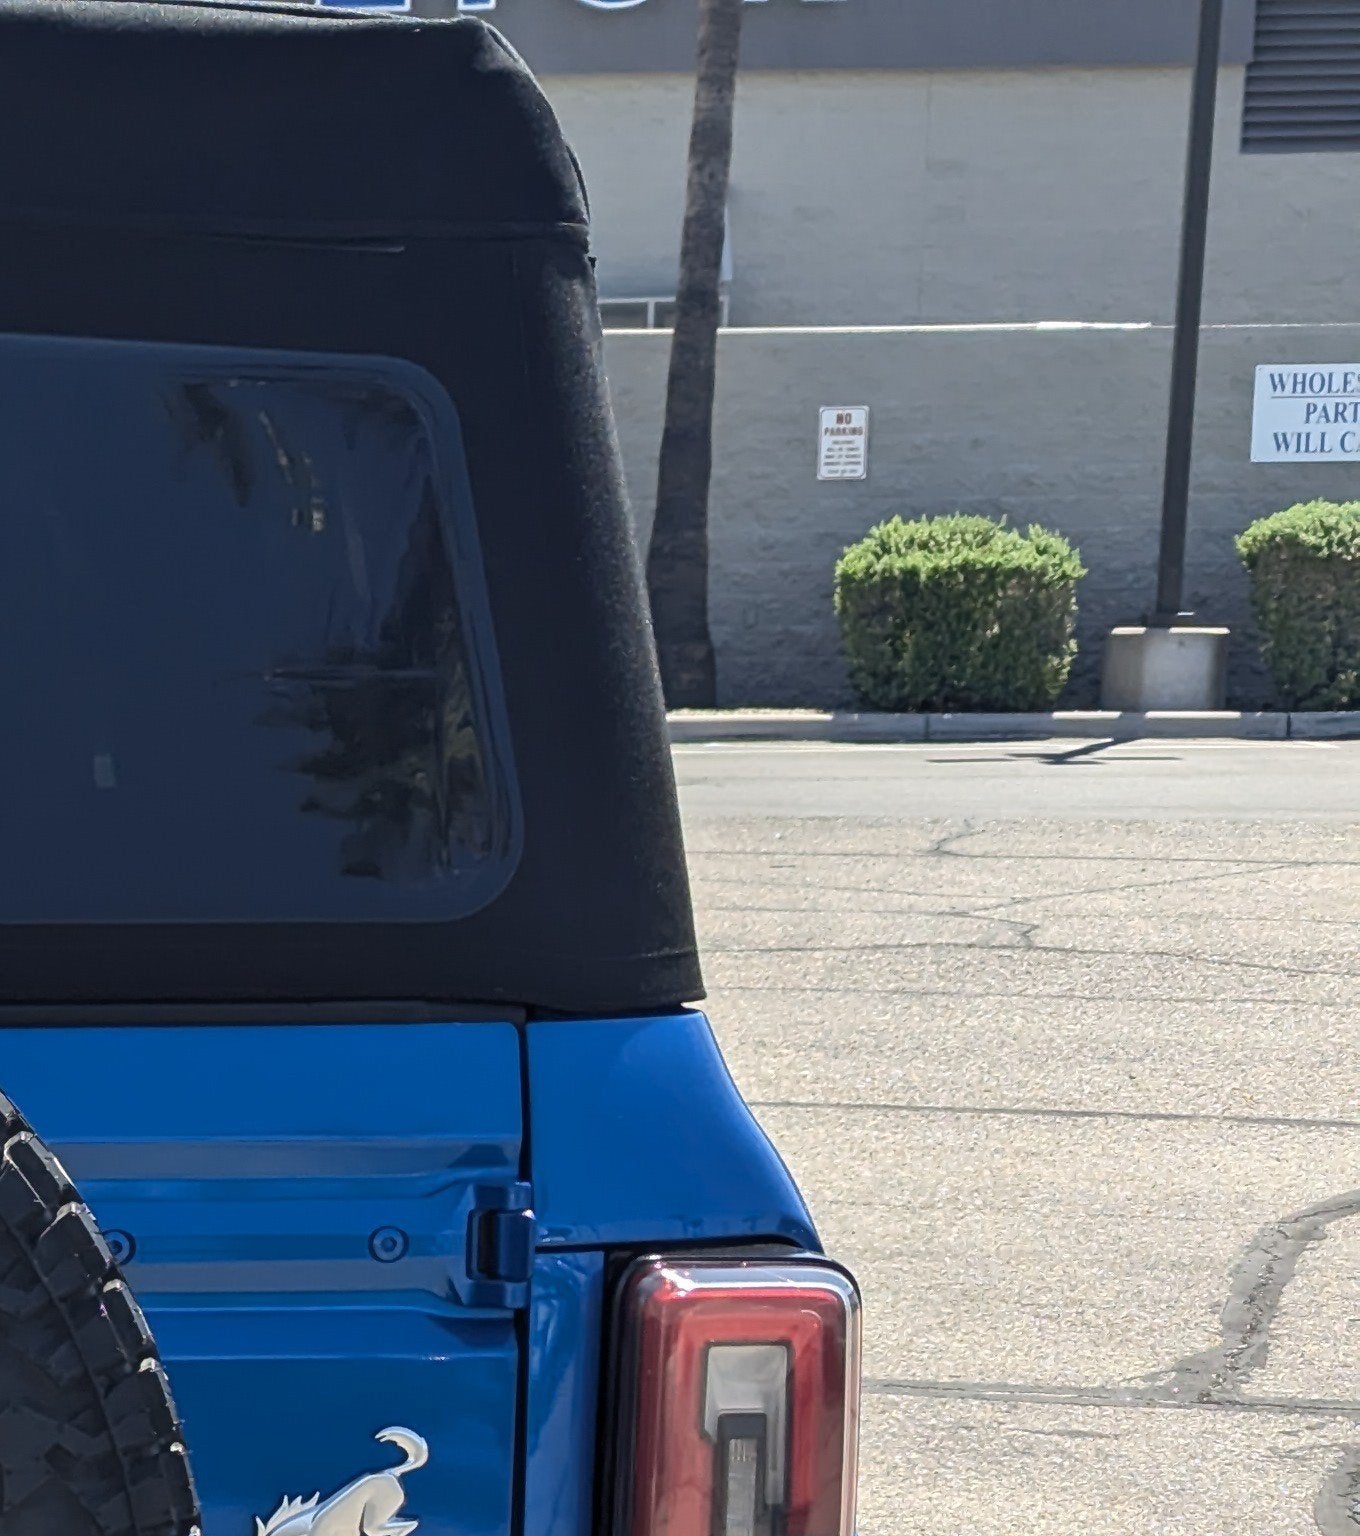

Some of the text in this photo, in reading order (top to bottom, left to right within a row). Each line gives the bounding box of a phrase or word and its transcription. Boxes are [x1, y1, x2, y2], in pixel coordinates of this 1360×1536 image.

[836, 412, 852, 425] NO
[1304, 402, 1360, 424] PART
[824, 426, 864, 436] PARKING
[1273, 431, 1360, 454] WILL C
